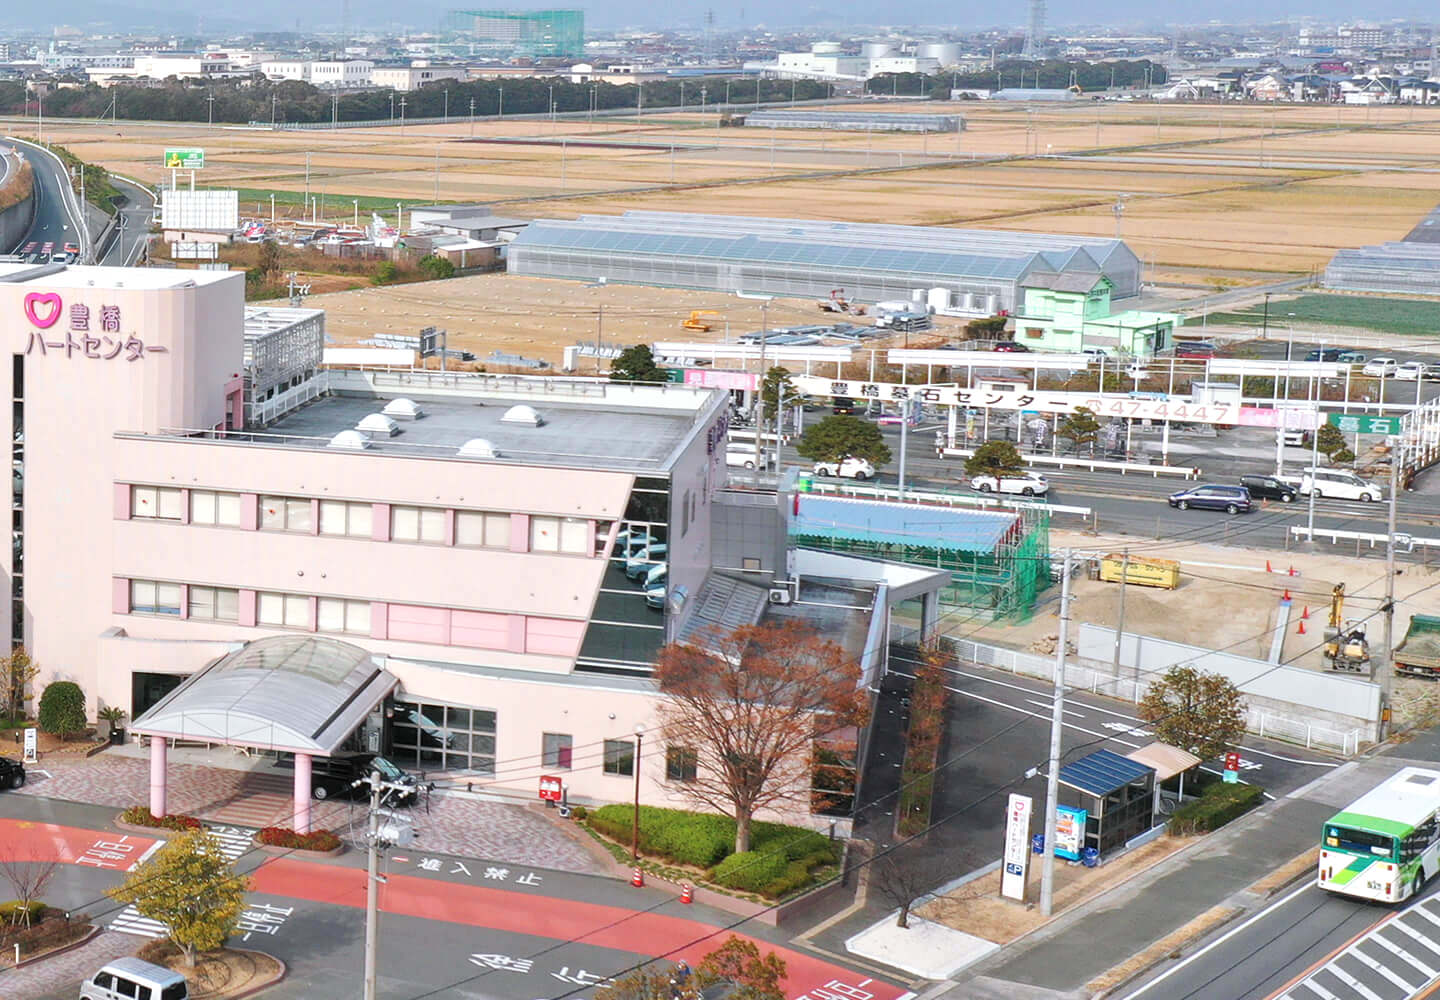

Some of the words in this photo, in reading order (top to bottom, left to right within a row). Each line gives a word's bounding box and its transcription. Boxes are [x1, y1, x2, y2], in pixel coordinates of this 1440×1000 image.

[70, 303, 121, 332] 豊橋
[26, 331, 168, 361] ハートセンター
[417, 857, 543, 886] 進入禁止
